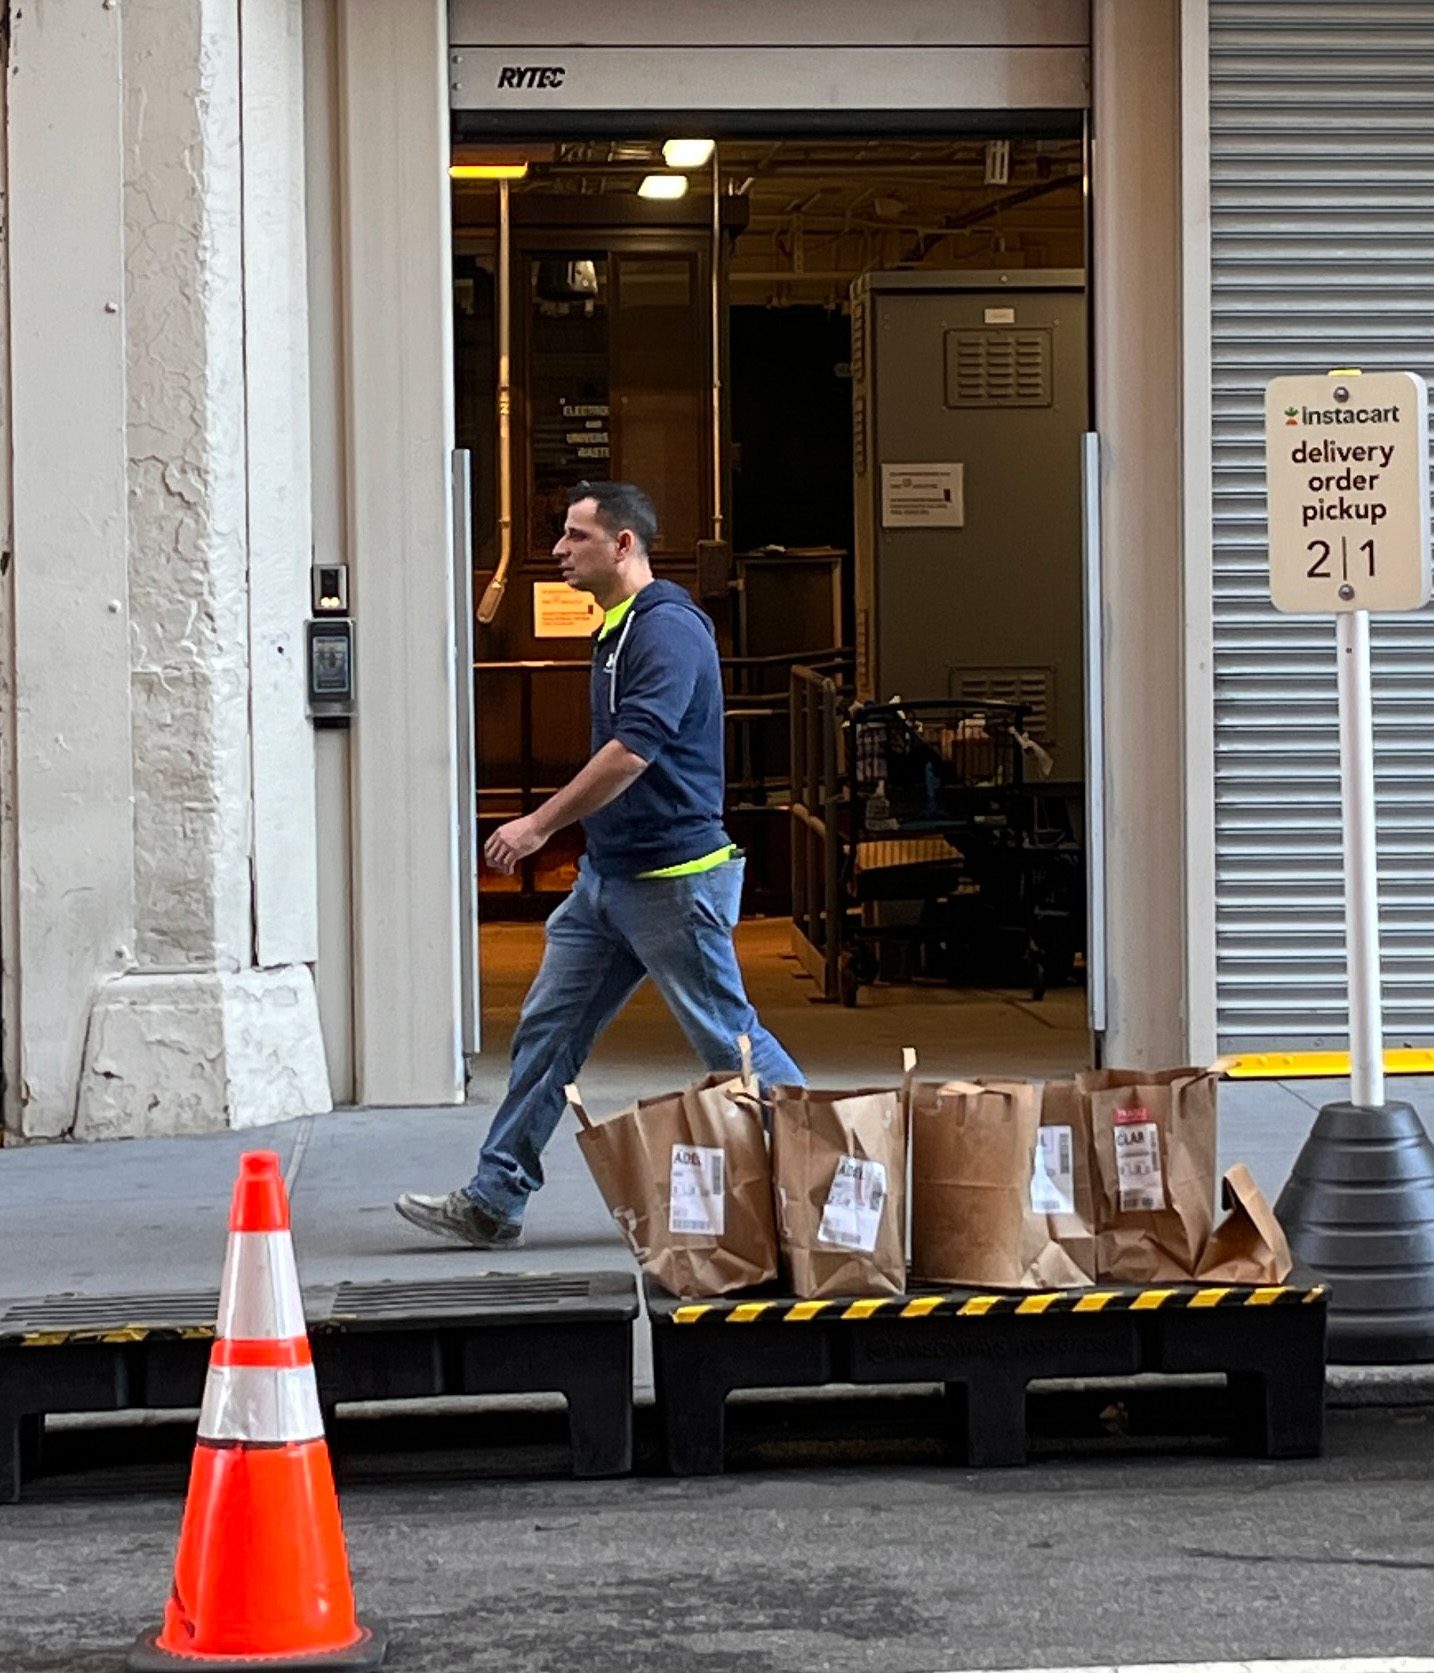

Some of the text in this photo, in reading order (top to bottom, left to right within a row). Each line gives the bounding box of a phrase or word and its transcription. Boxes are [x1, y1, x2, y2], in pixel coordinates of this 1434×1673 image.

[497, 66, 566, 89] RYTEC
[1291, 438, 1394, 468] delivery
[1308, 467, 1380, 492] order
[1302, 496, 1387, 527] pickup
